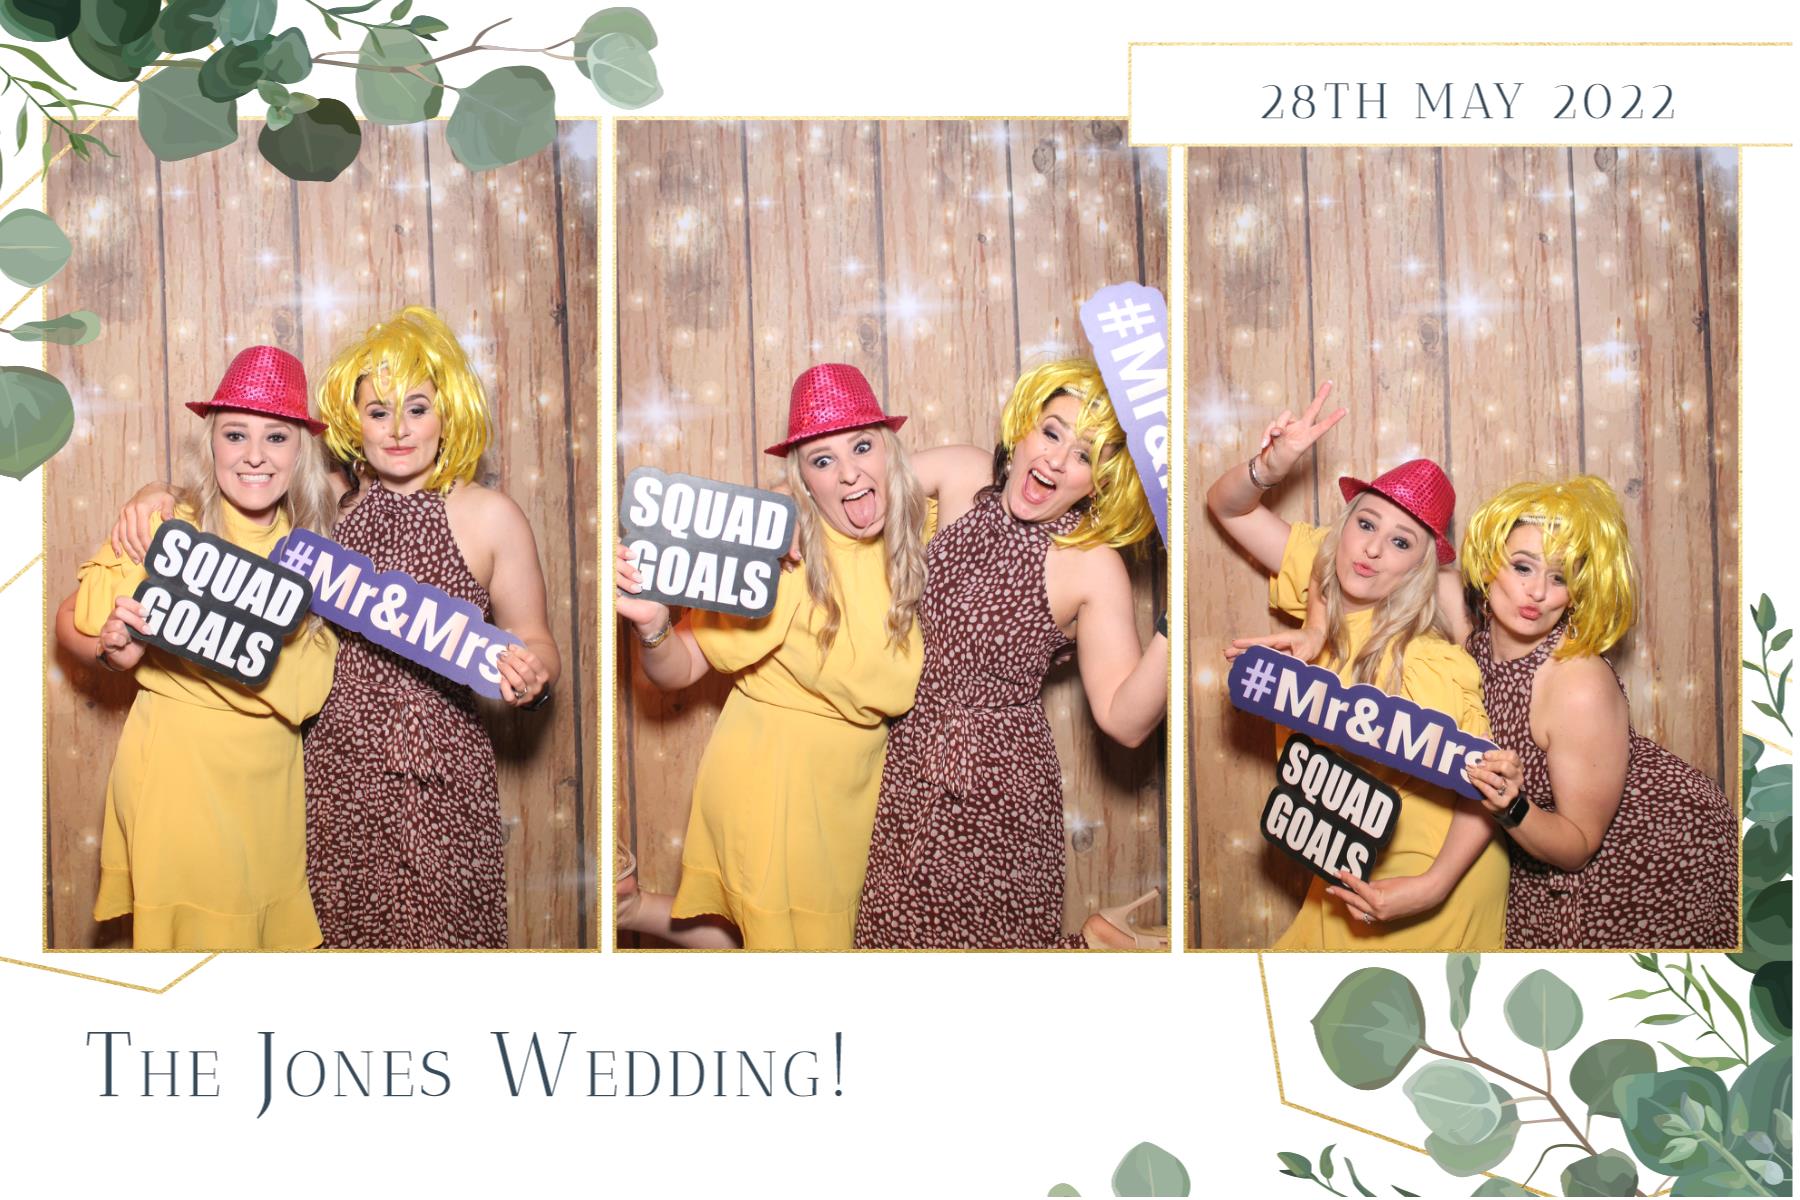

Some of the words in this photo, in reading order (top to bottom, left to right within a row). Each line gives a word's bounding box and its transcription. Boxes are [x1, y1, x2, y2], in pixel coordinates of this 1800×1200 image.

[629, 476, 789, 550] SQUAD
[153, 529, 304, 627] SQUAD
[278, 541, 508, 684] #Mr&Mrs
[627, 539, 772, 610] GOALS
[139, 586, 274, 678] GOALS
[1282, 741, 1394, 839] SQUAD
[1266, 793, 1369, 883] GOALS
